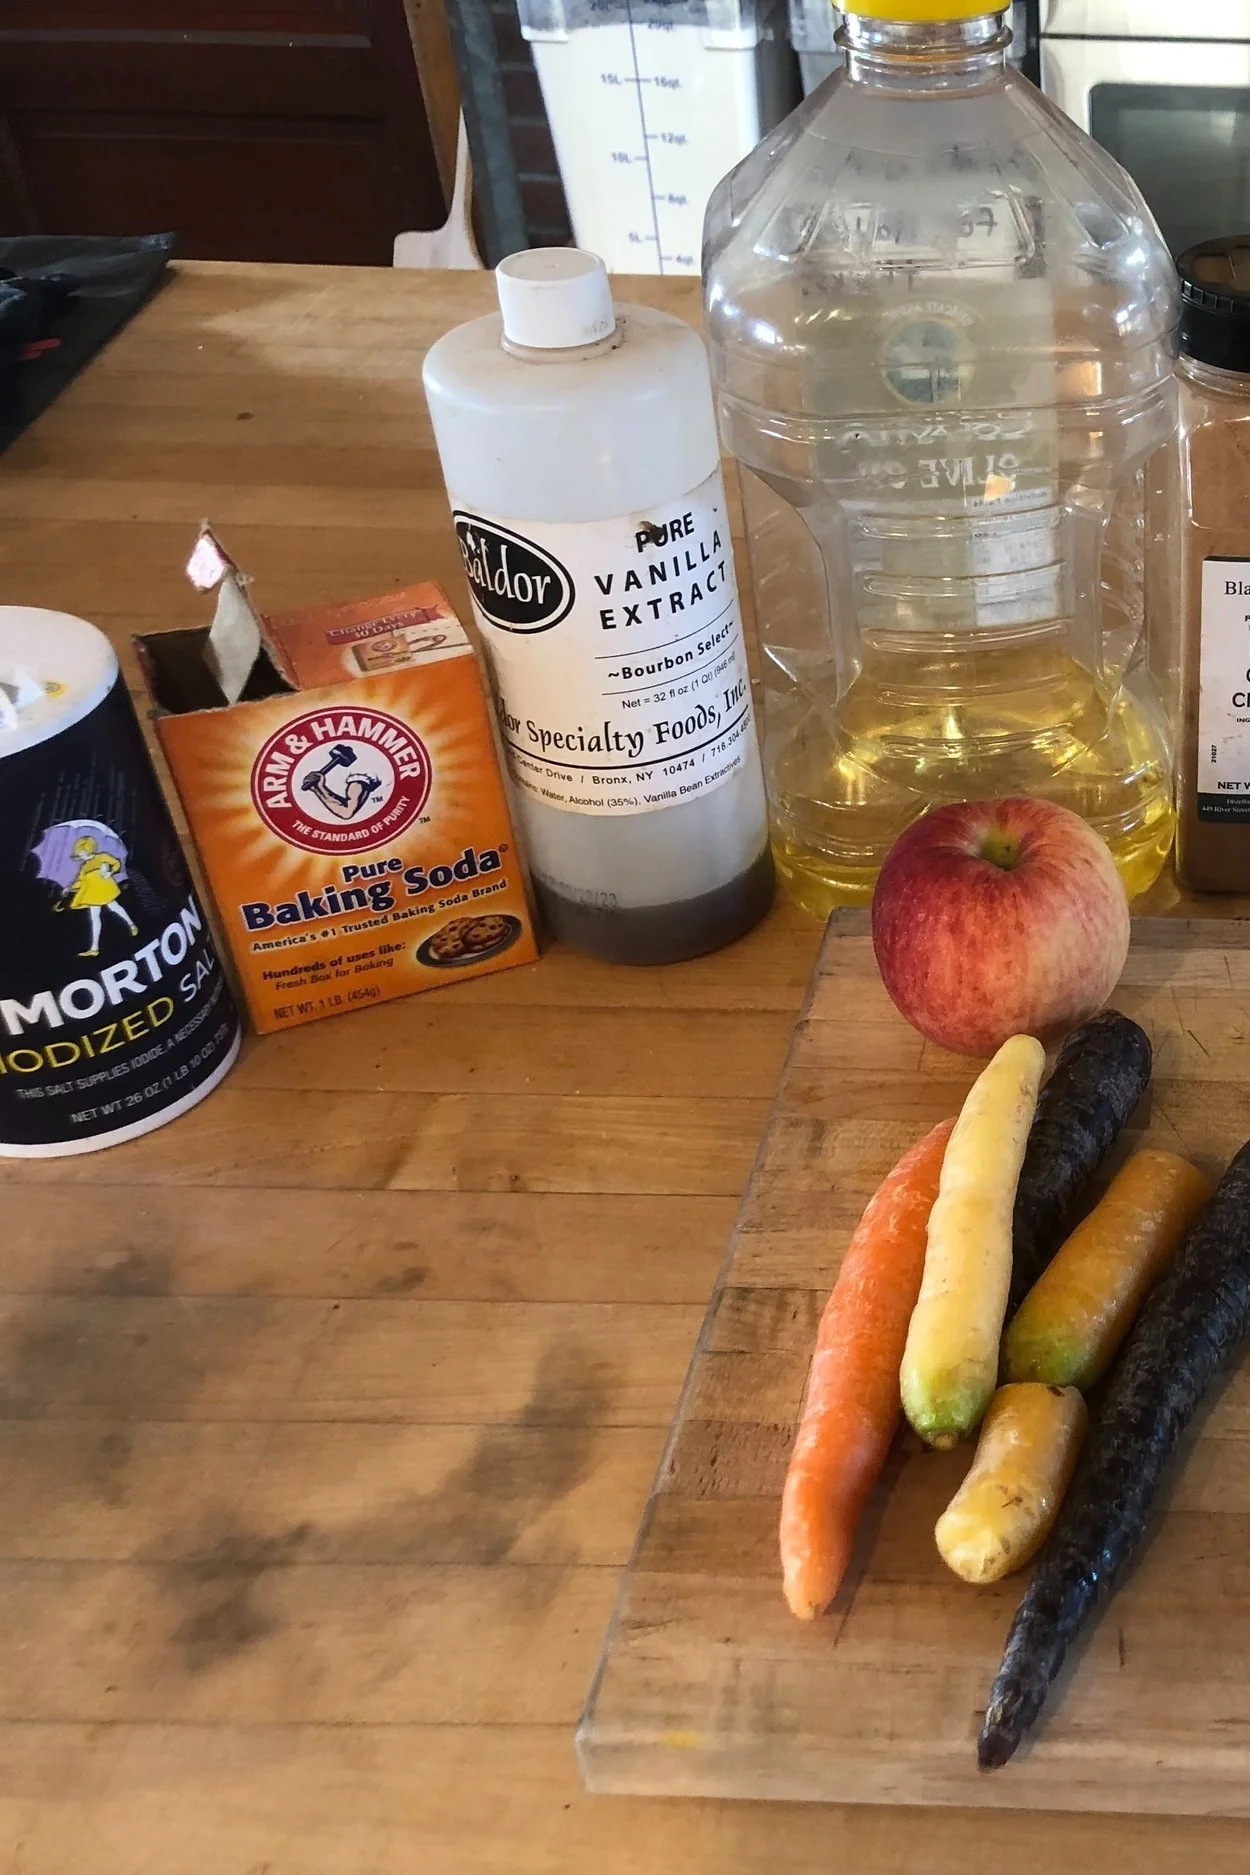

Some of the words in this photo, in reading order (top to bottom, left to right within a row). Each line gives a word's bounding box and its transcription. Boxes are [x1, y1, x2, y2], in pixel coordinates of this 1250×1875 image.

[635, 512, 694, 553] PURE
[458, 535, 551, 604] Baldor
[594, 530, 721, 595] VANILLA
[600, 560, 725, 630] EXTRACT
[622, 699, 641, 710] Net
[654, 692, 666, 703] 32
[669, 688, 676, 698] fl
[678, 685, 689, 695] oz
[691, 680, 700, 692] (1
[701, 670, 713, 685] Qt)
[526, 720, 644, 758] Specialty
[653, 704, 721, 745] Foods,
[723, 678, 748, 712] Inc.
[264, 751, 295, 808] ARM
[285, 734, 314, 755] &
[310, 716, 421, 780] HAMMER
[546, 768, 573, 782] Drive
[636, 771, 654, 782] NY
[663, 758, 695, 776] 10474
[569, 795, 604, 807] Alcohol
[644, 790, 677, 804] Vanilla
[679, 781, 703, 794] Bean
[705, 755, 741, 784] Extractives
[1217, 781, 1241, 790] NET
[291, 820, 310, 835] THE
[311, 829, 370, 842] STANDARD
[371, 822, 385, 834] OF
[385, 795, 411, 826] PURITY
[419, 816, 431, 824] TM
[241, 880, 395, 931] Baking
[403, 847, 502, 894] Soda
[343, 857, 403, 882] Pure
[253, 932, 317, 952] America's
[321, 927, 337, 938] #1
[342, 914, 389, 934] Trusted
[392, 902, 436, 921] Baking
[438, 893, 469, 909] Soda
[472, 879, 508, 898] Brand
[0, 894, 203, 1035] MORTON
[262, 960, 327, 981] Hundreds
[329, 955, 345, 968] of
[346, 951, 376, 965] uses
[379, 941, 407, 958] like:
[275, 976, 307, 991] Fresh
[310, 972, 332, 985] Box
[335, 968, 351, 978] for
[354, 956, 394, 974] Baking
[0, 997, 175, 1074] IODIZED
[179, 940, 215, 1003] SAL
[274, 1006, 295, 1021] NET
[319, 998, 325, 1008] 1
[347, 986, 380, 1004] (454g)
[16, 1086, 45, 1100] THIS
[46, 1081, 75, 1097] SALT
[76, 1062, 130, 1091] SUPPLIES
[70, 1108, 98, 1123] NET
[101, 1099, 122, 1116] WT
[125, 1092, 143, 1108] 26
[145, 1082, 161, 1099] OZ
[175, 1064, 190, 1081] LB
[189, 1054, 200, 1068] 10
